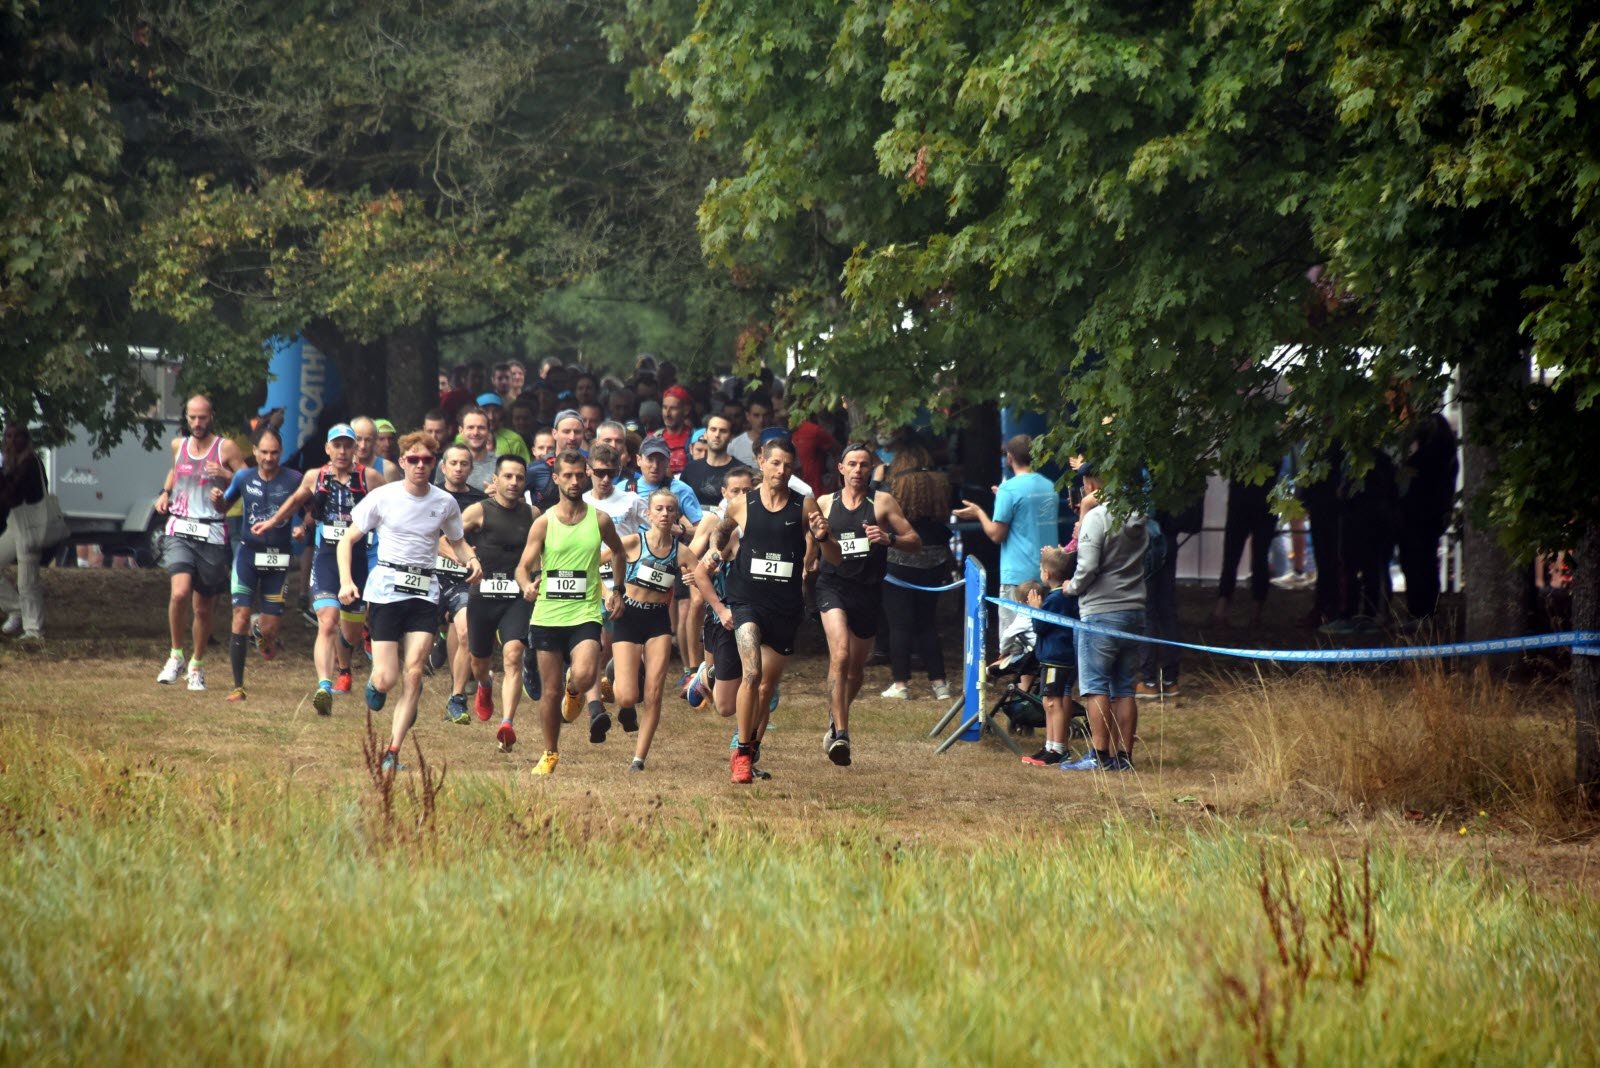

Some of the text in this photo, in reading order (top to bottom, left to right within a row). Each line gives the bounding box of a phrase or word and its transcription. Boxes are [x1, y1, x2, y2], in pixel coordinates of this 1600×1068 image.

[186, 523, 198, 533] 30
[334, 528, 345, 537] 54
[842, 540, 856, 552] 34
[266, 554, 278, 564] 28
[765, 561, 778, 573] 21
[404, 574, 422, 587] 221
[650, 570, 664, 582] 95
[490, 581, 509, 591] 107
[556, 579, 576, 590] 102
[624, 597, 651, 610] NIKE
